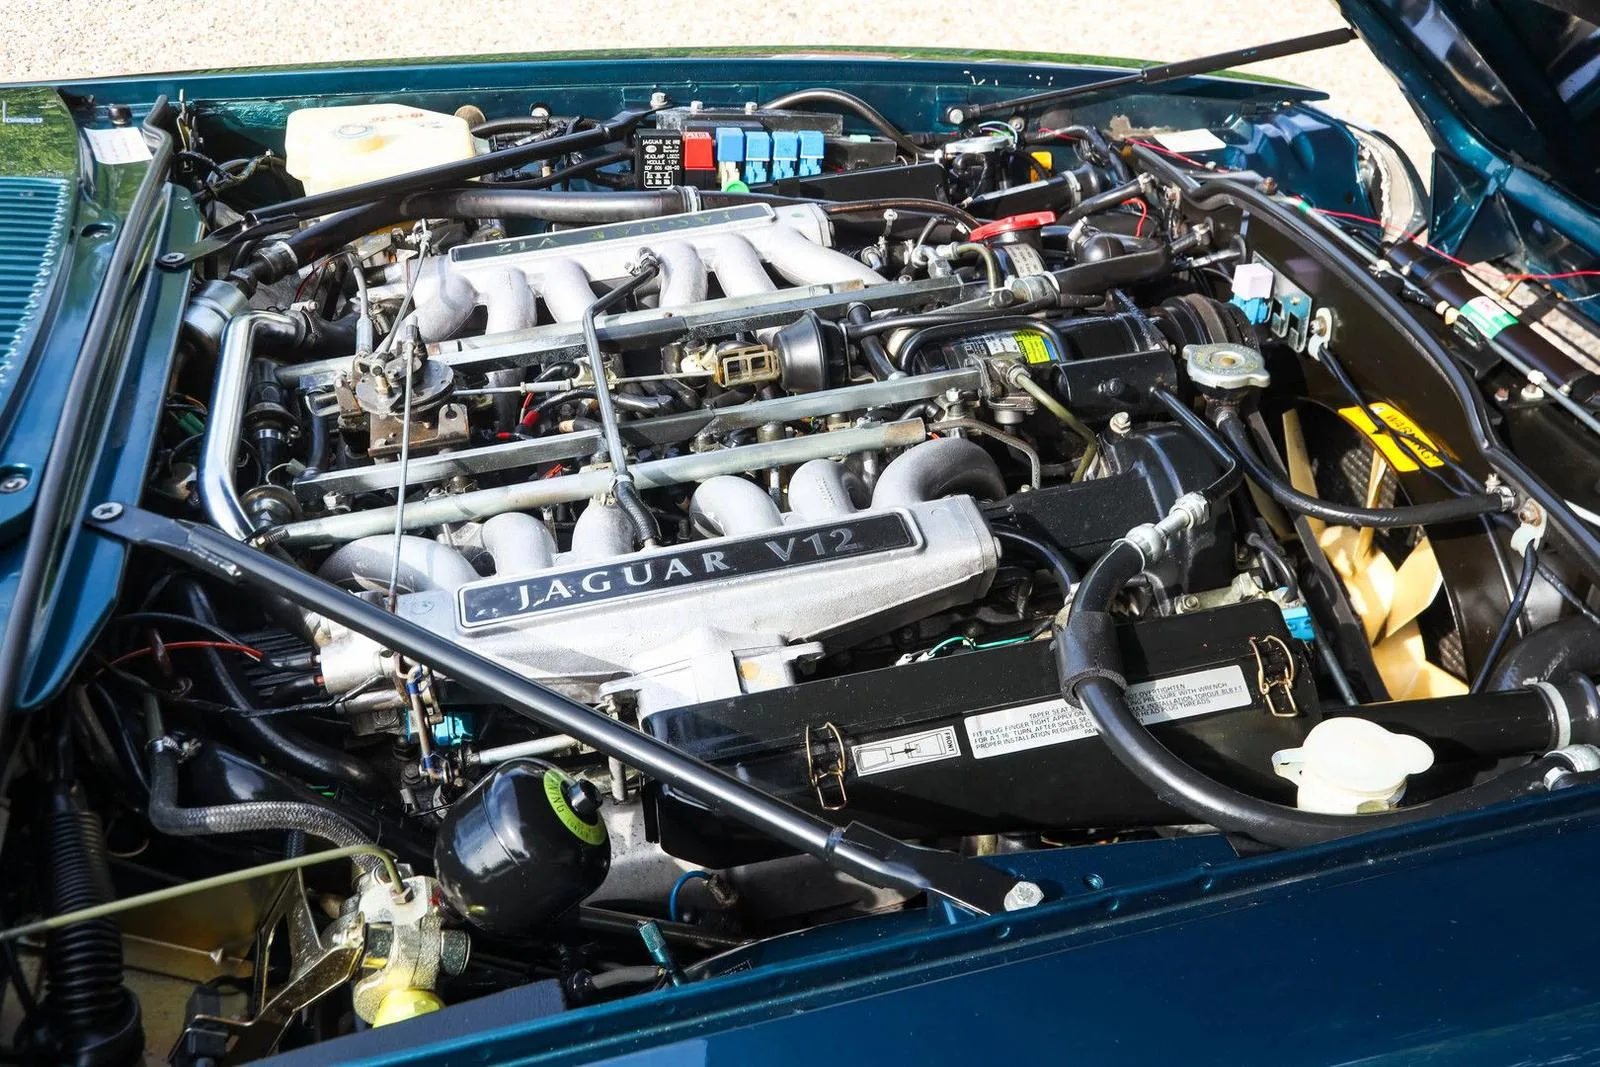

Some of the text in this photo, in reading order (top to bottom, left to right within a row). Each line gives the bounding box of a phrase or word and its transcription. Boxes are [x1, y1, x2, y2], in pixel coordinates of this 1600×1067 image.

[517, 527, 860, 611] JAGUAR V12
[1179, 688, 1196, 696] WITH
[1198, 682, 1227, 692] WRENCH
[1029, 710, 1050, 719] TAPER
[1052, 707, 1069, 715] SEAT
[1143, 708, 1159, 716] HEAD
[1161, 704, 1178, 712] PLUG
[1180, 698, 1211, 709] THREADS
[984, 727, 1003, 736] PLUG
[1004, 722, 1029, 732] FINGER
[1052, 713, 1072, 722] APPLY
[1035, 723, 1057, 732] AFTER
[1058, 718, 1077, 727] SHELL
[945, 732, 954, 753] FRONT
[975, 739, 1003, 750] PROPER
[1003, 730, 1050, 745] INSTALLATION
